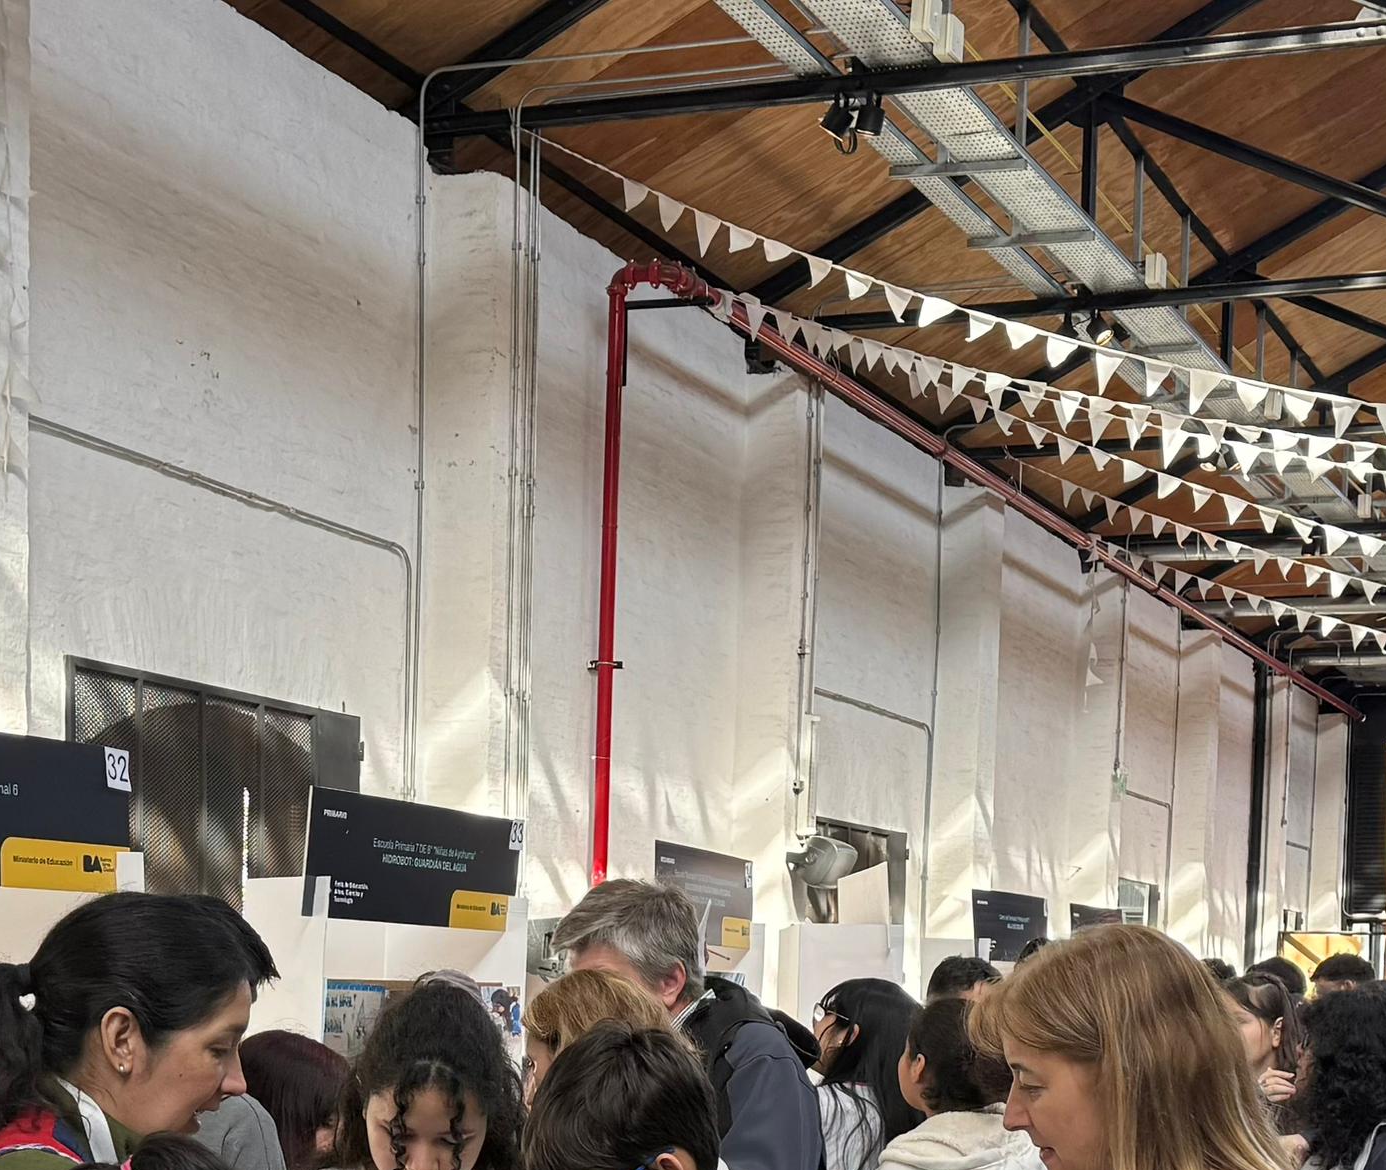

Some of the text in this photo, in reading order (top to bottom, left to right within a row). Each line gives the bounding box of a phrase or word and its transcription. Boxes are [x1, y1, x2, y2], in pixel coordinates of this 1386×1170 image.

[107, 753, 129, 782] 32
[12, 783, 19, 796] 6
[511, 822, 523, 843] 33
[83, 855, 103, 873] BA
